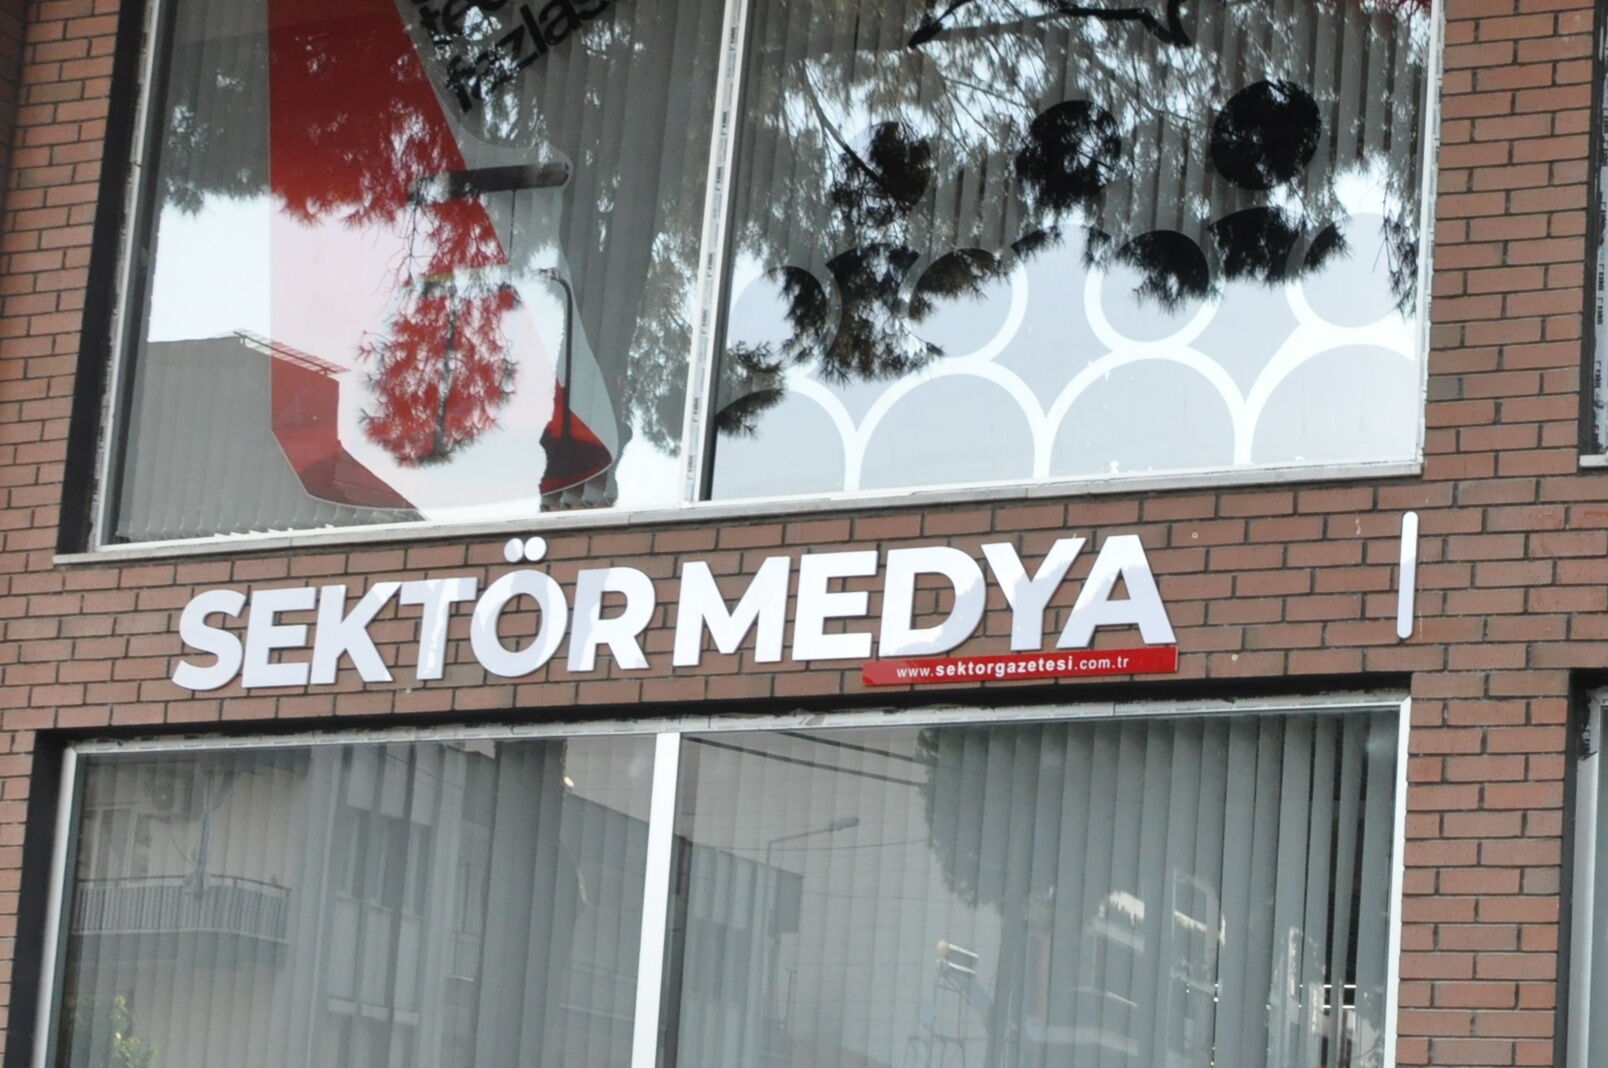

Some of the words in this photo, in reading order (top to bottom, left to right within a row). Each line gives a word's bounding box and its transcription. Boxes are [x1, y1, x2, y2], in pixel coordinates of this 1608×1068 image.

[171, 537, 656, 691] SEKTÖR
[673, 534, 1177, 667] MEDYA
[896, 656, 1131, 678] www.sektorgazetesi.com.tr
